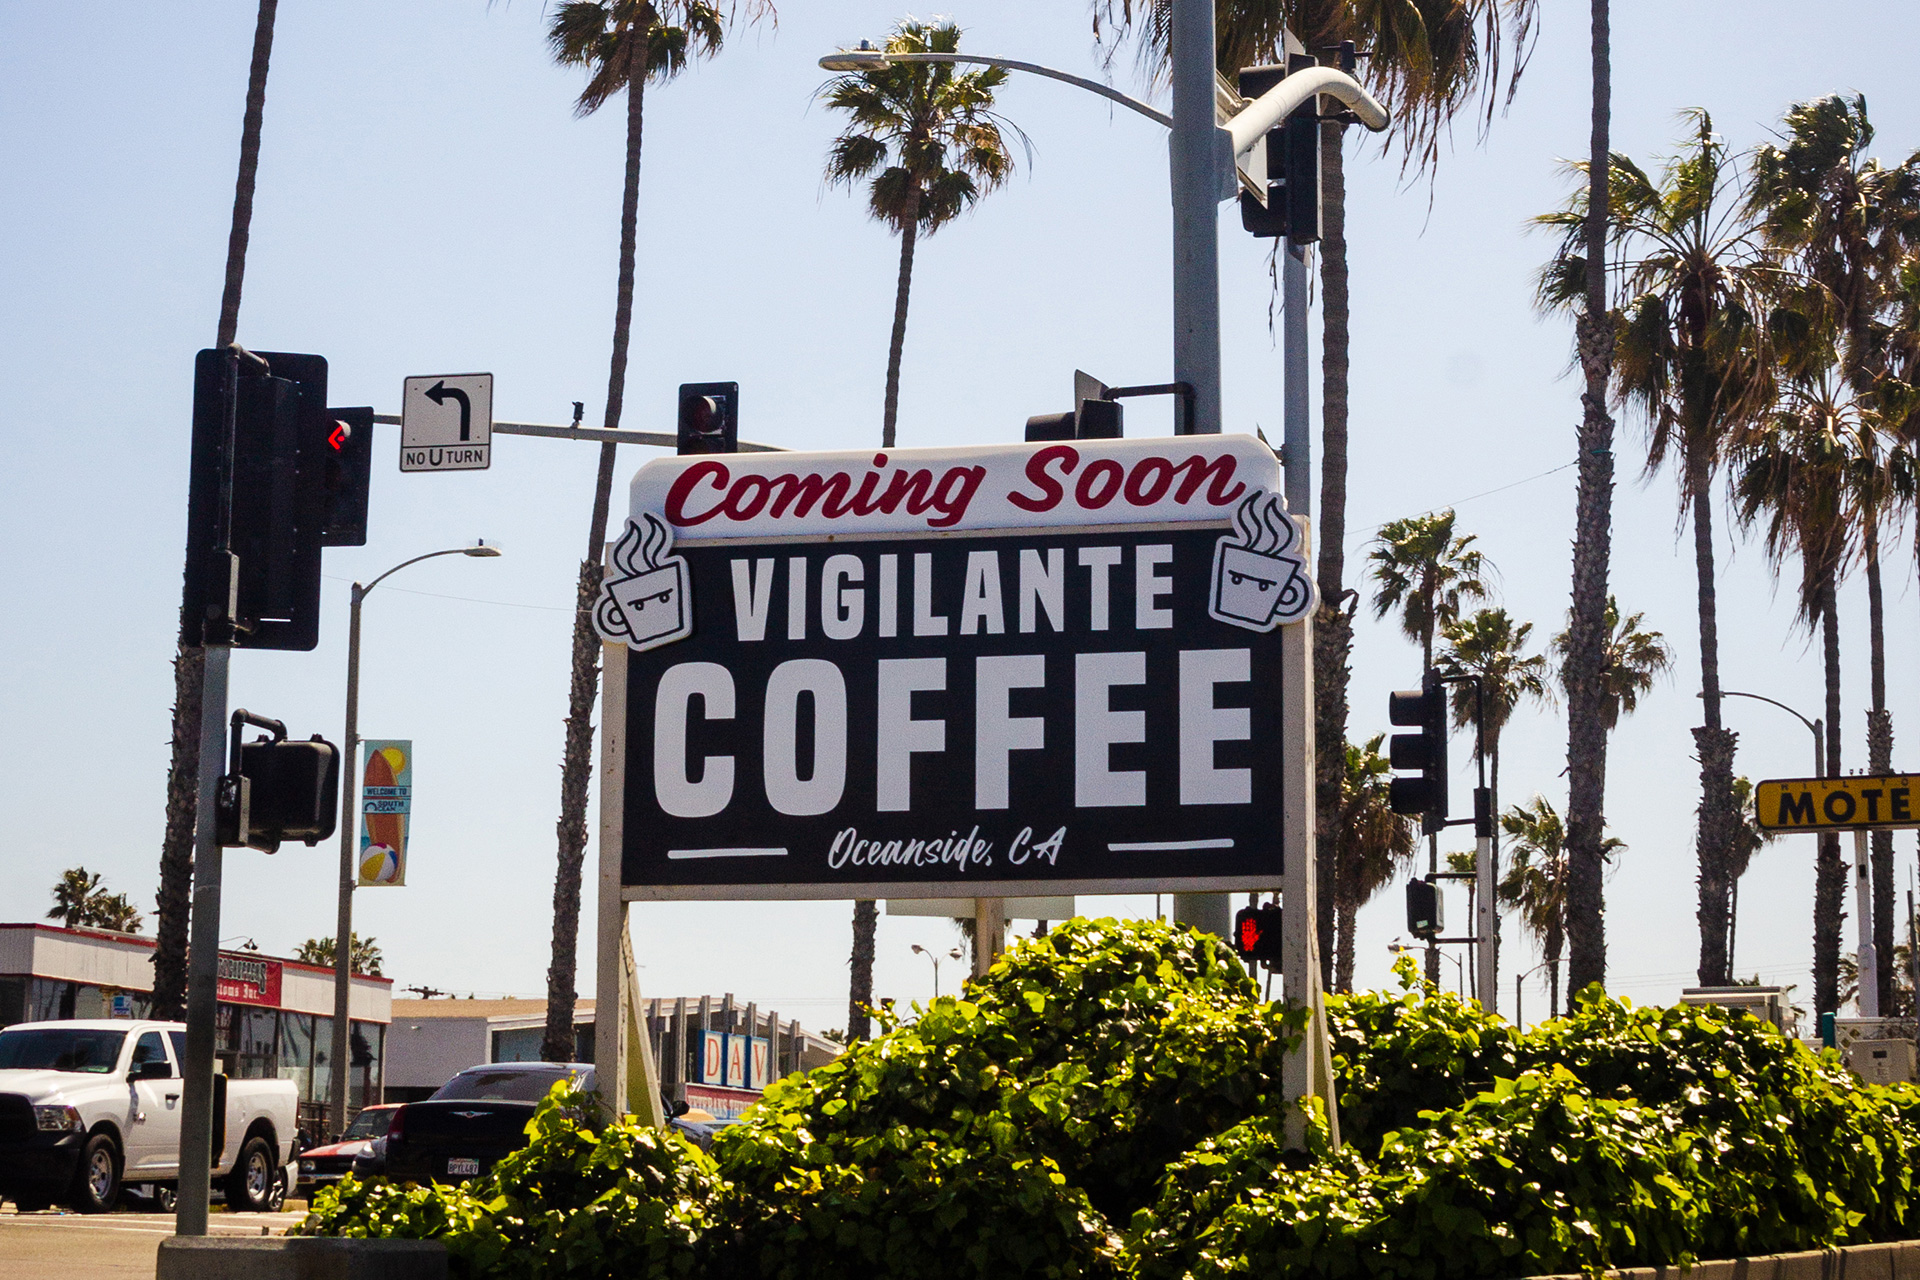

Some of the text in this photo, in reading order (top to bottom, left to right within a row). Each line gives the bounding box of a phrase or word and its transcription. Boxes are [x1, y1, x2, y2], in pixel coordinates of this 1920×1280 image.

[406, 448, 483, 466] NO U TURN
[665, 445, 1246, 527] Coming Soon
[730, 543, 1174, 642] VIGILANTE
[653, 648, 1252, 818] COFFEE
[366, 787, 396, 795] WELCOME
[1879, 778, 1910, 787] TO
[1777, 787, 1912, 825] MOTE
[827, 825, 1067, 873] Oceanside, CA
[706, 1038, 767, 1083] DAV
